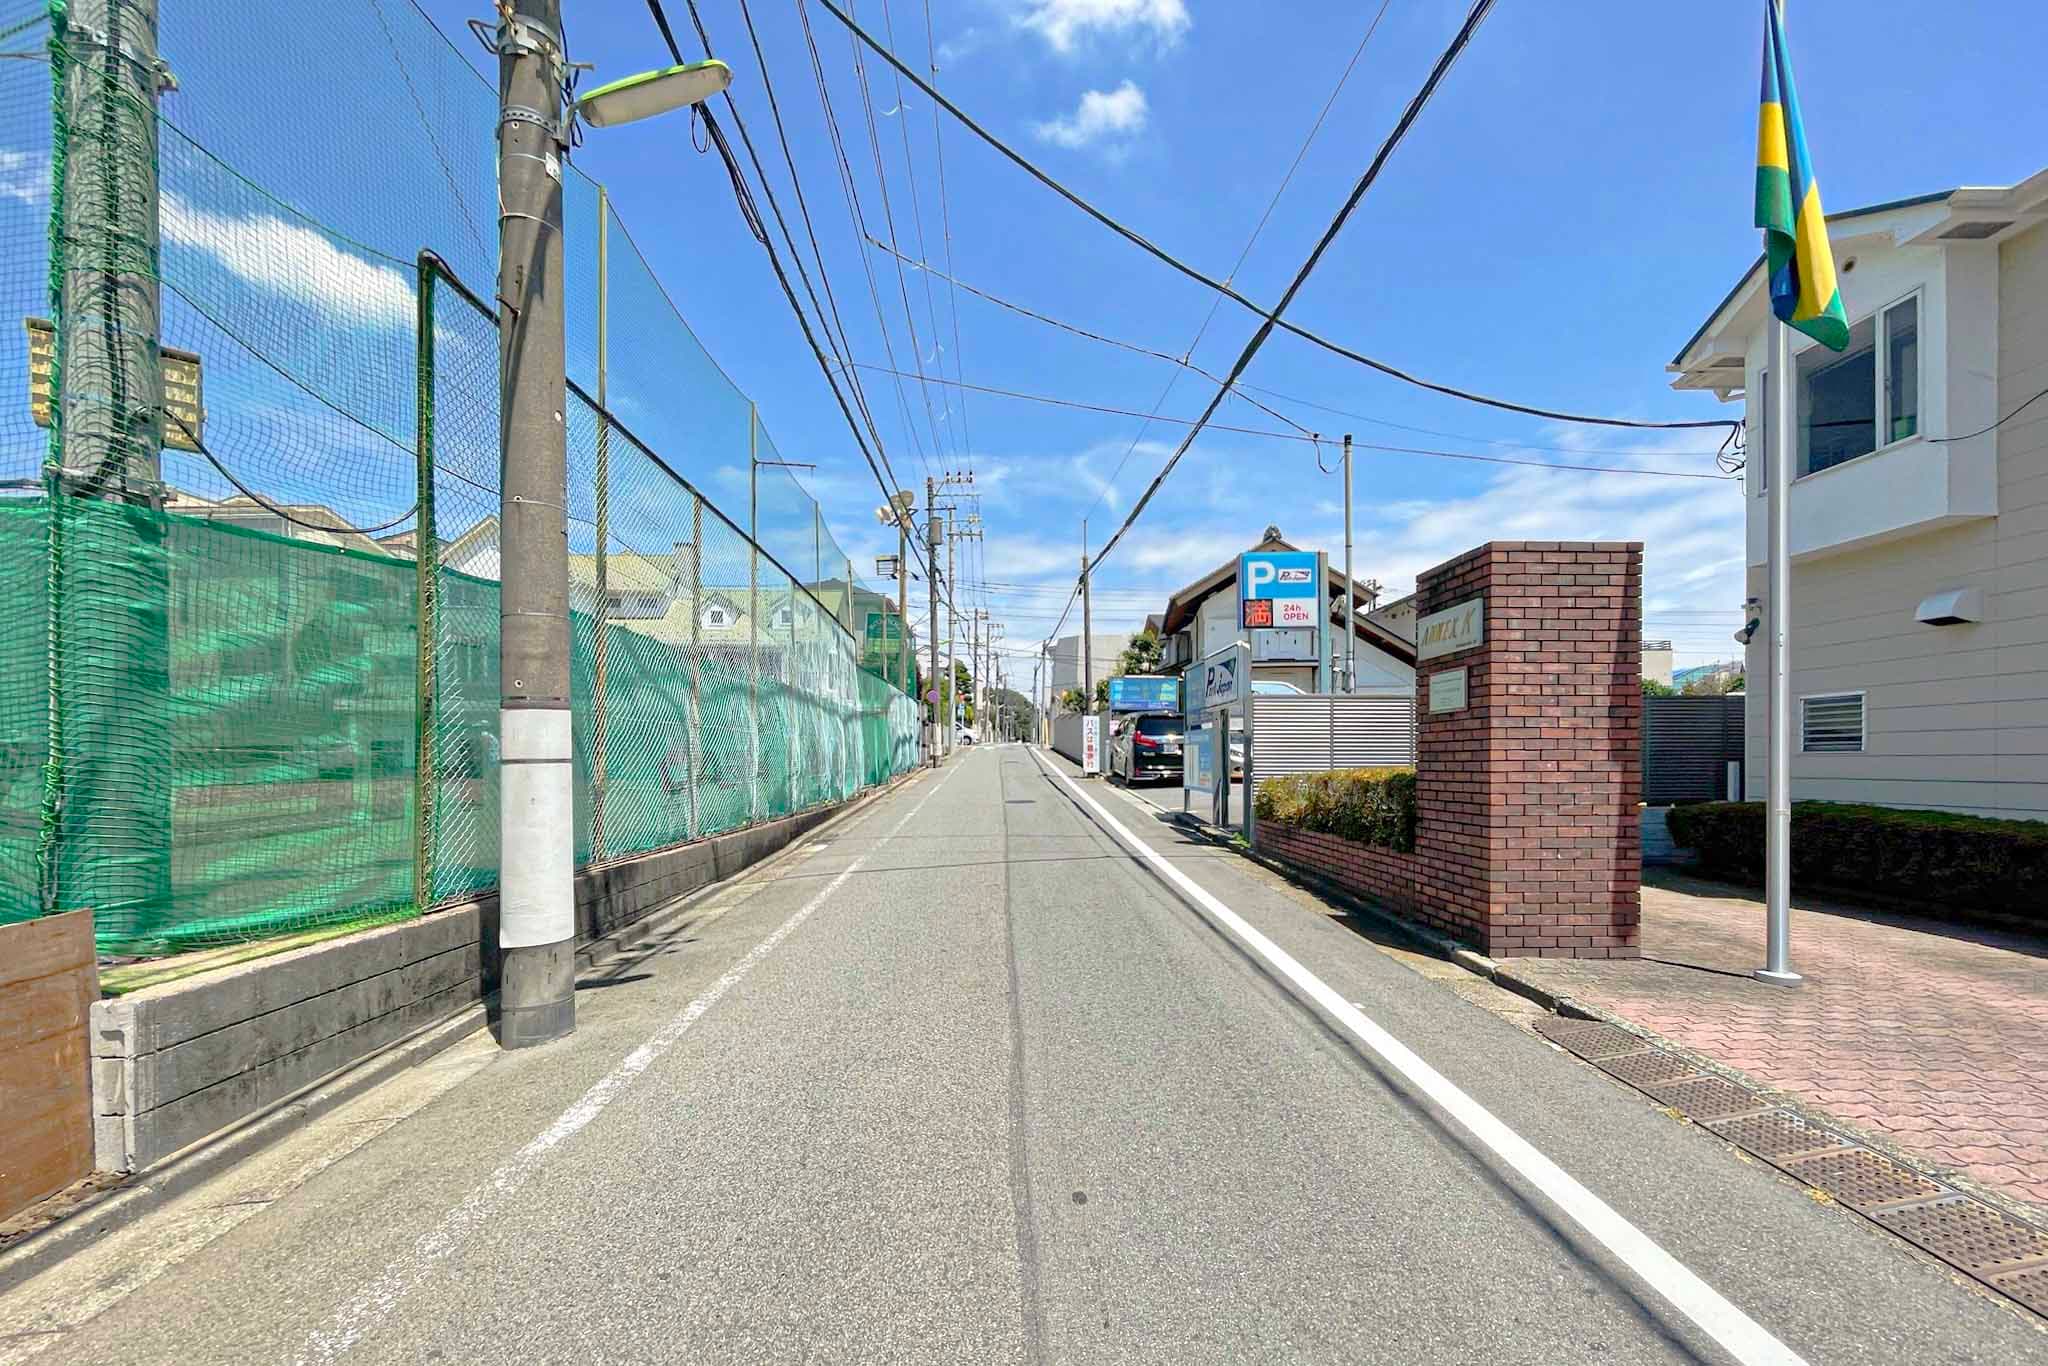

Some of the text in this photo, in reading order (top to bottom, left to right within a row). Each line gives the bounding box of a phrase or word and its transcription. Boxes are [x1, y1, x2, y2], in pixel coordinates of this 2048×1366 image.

[1248, 561, 1275, 600] P
[1283, 604, 1302, 612] 24h
[1283, 612, 1310, 621] OPEN
